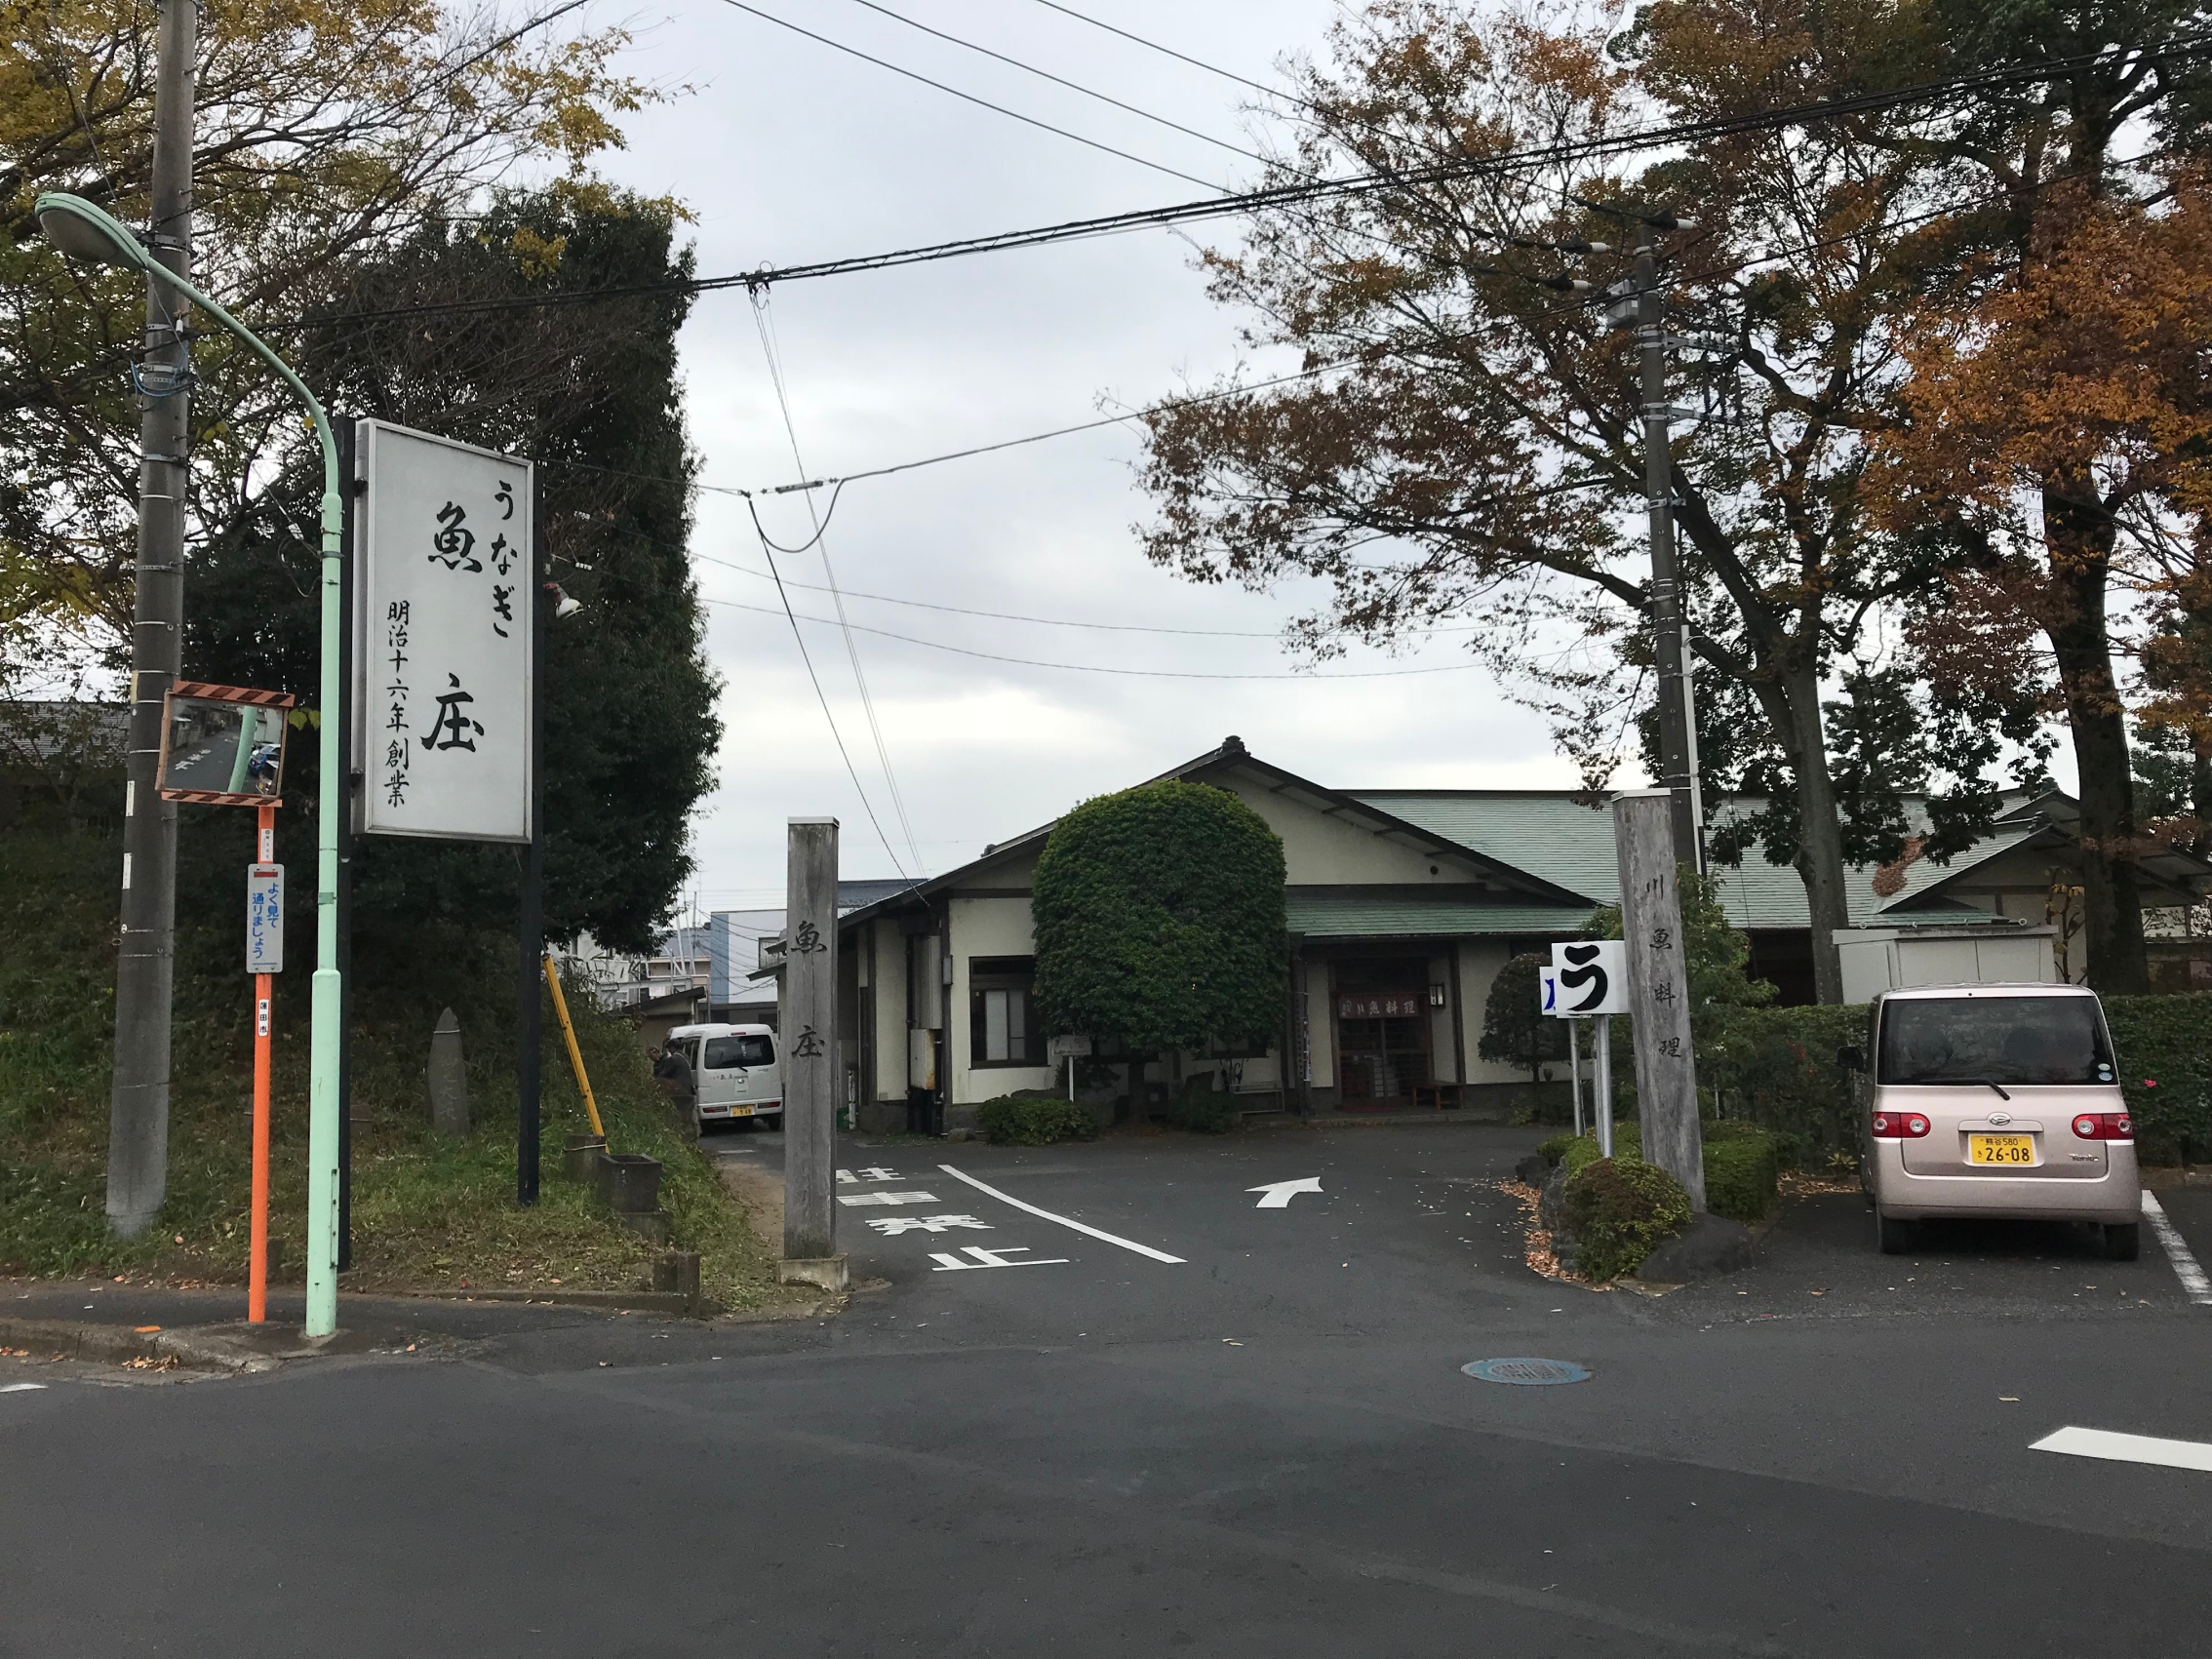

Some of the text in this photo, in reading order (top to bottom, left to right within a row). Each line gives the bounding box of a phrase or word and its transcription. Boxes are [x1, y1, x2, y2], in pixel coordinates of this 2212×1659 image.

[421, 500, 485, 754] 魚庄
[491, 480, 518, 639] うなぎ
[384, 600, 411, 809] 明治十六年創業
[253, 892, 265, 959] 通りましょう
[266, 882, 279, 928] よく見て
[1646, 874, 1681, 1058] 川魚料理
[790, 920, 828, 1060] 魚庄
[1560, 944, 1608, 1011] う
[1986, 1147, 2031, 1163] 26-08
